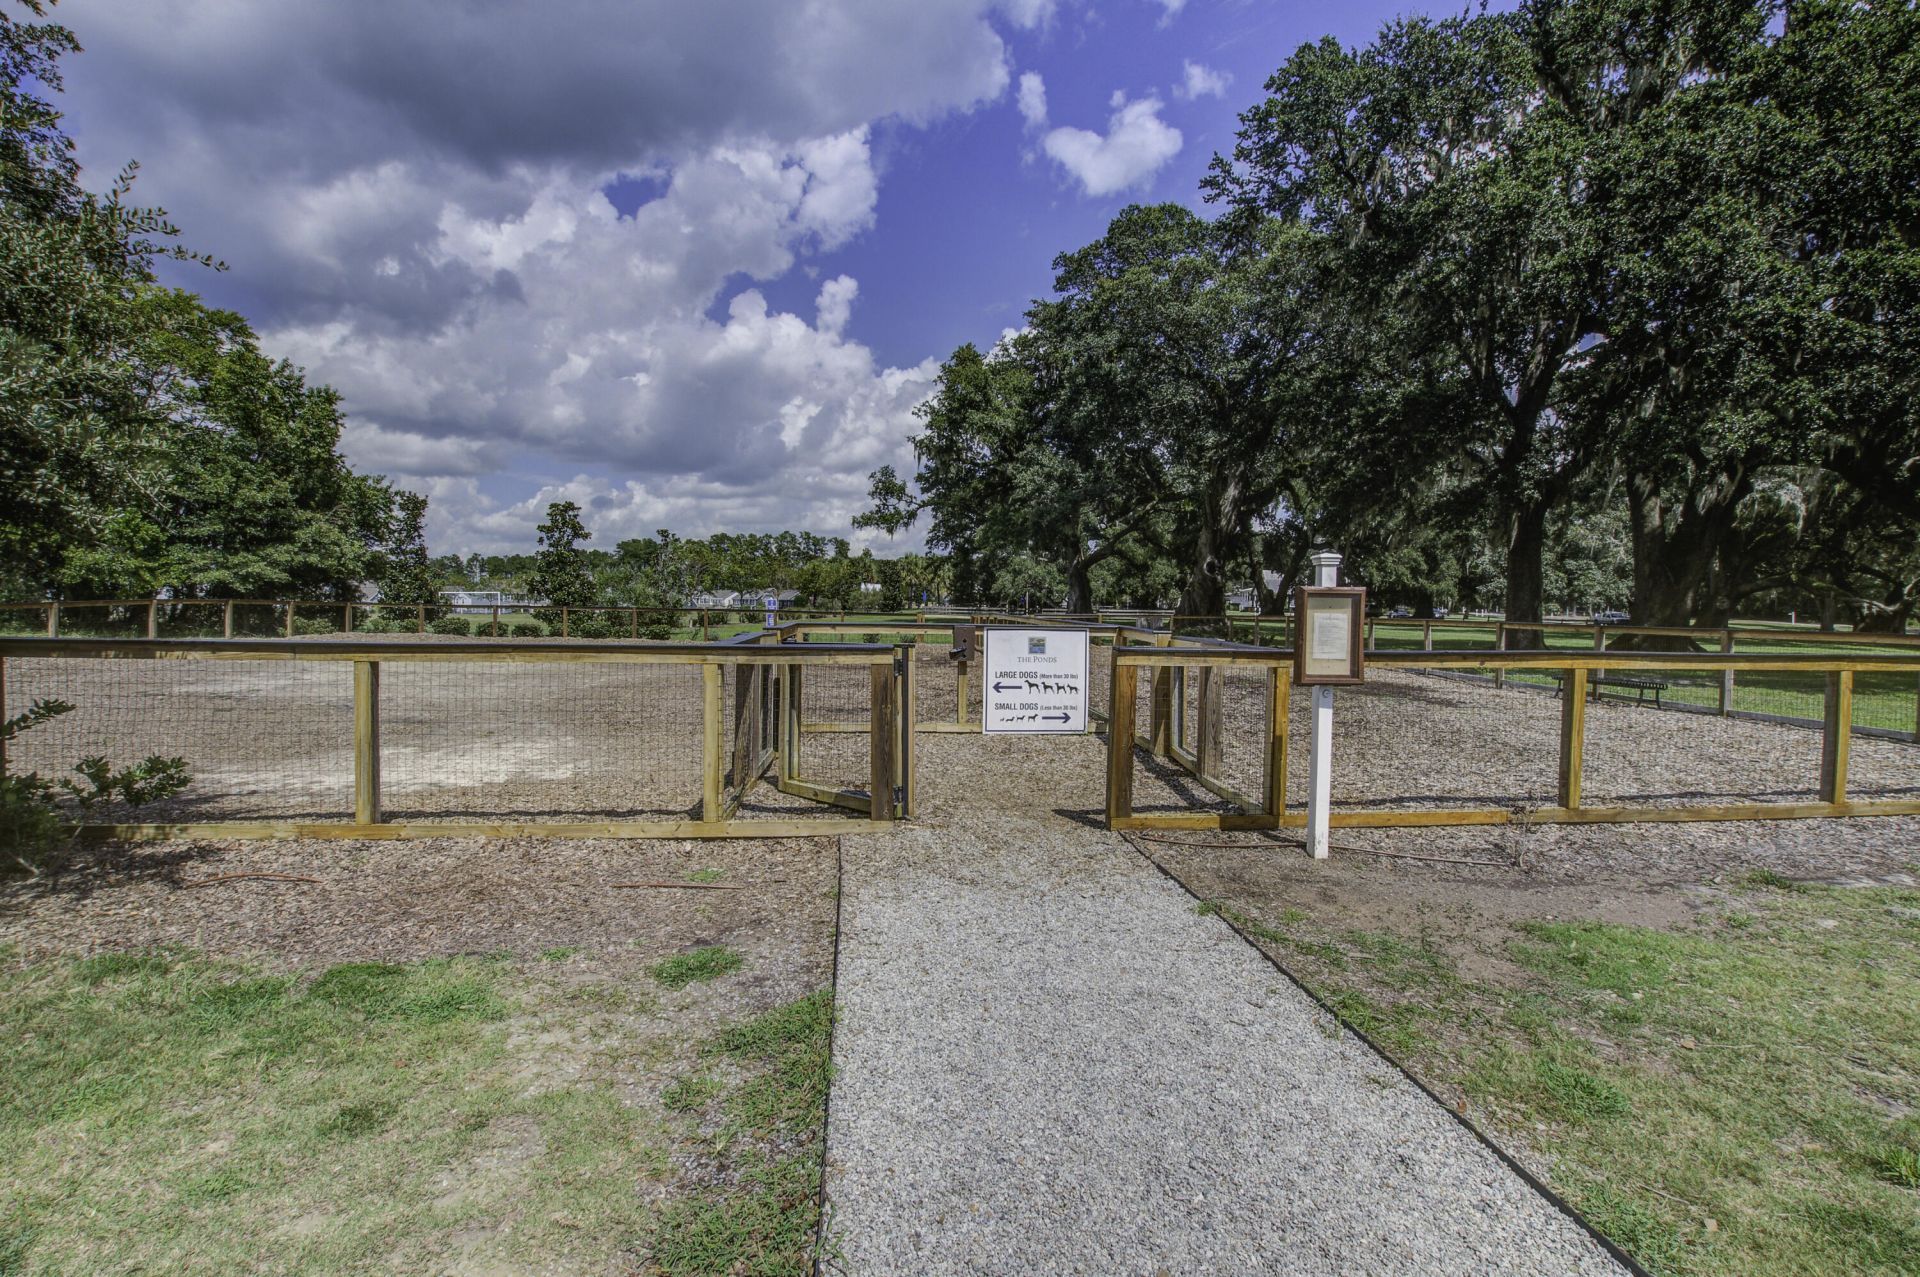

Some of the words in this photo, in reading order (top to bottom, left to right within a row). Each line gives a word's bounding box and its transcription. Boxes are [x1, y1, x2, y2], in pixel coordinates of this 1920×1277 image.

[995, 671, 1017, 679] LARGE
[1019, 671, 1038, 679] DOGS
[994, 703, 1017, 711] SMALL
[1019, 703, 1039, 711] DOGS
